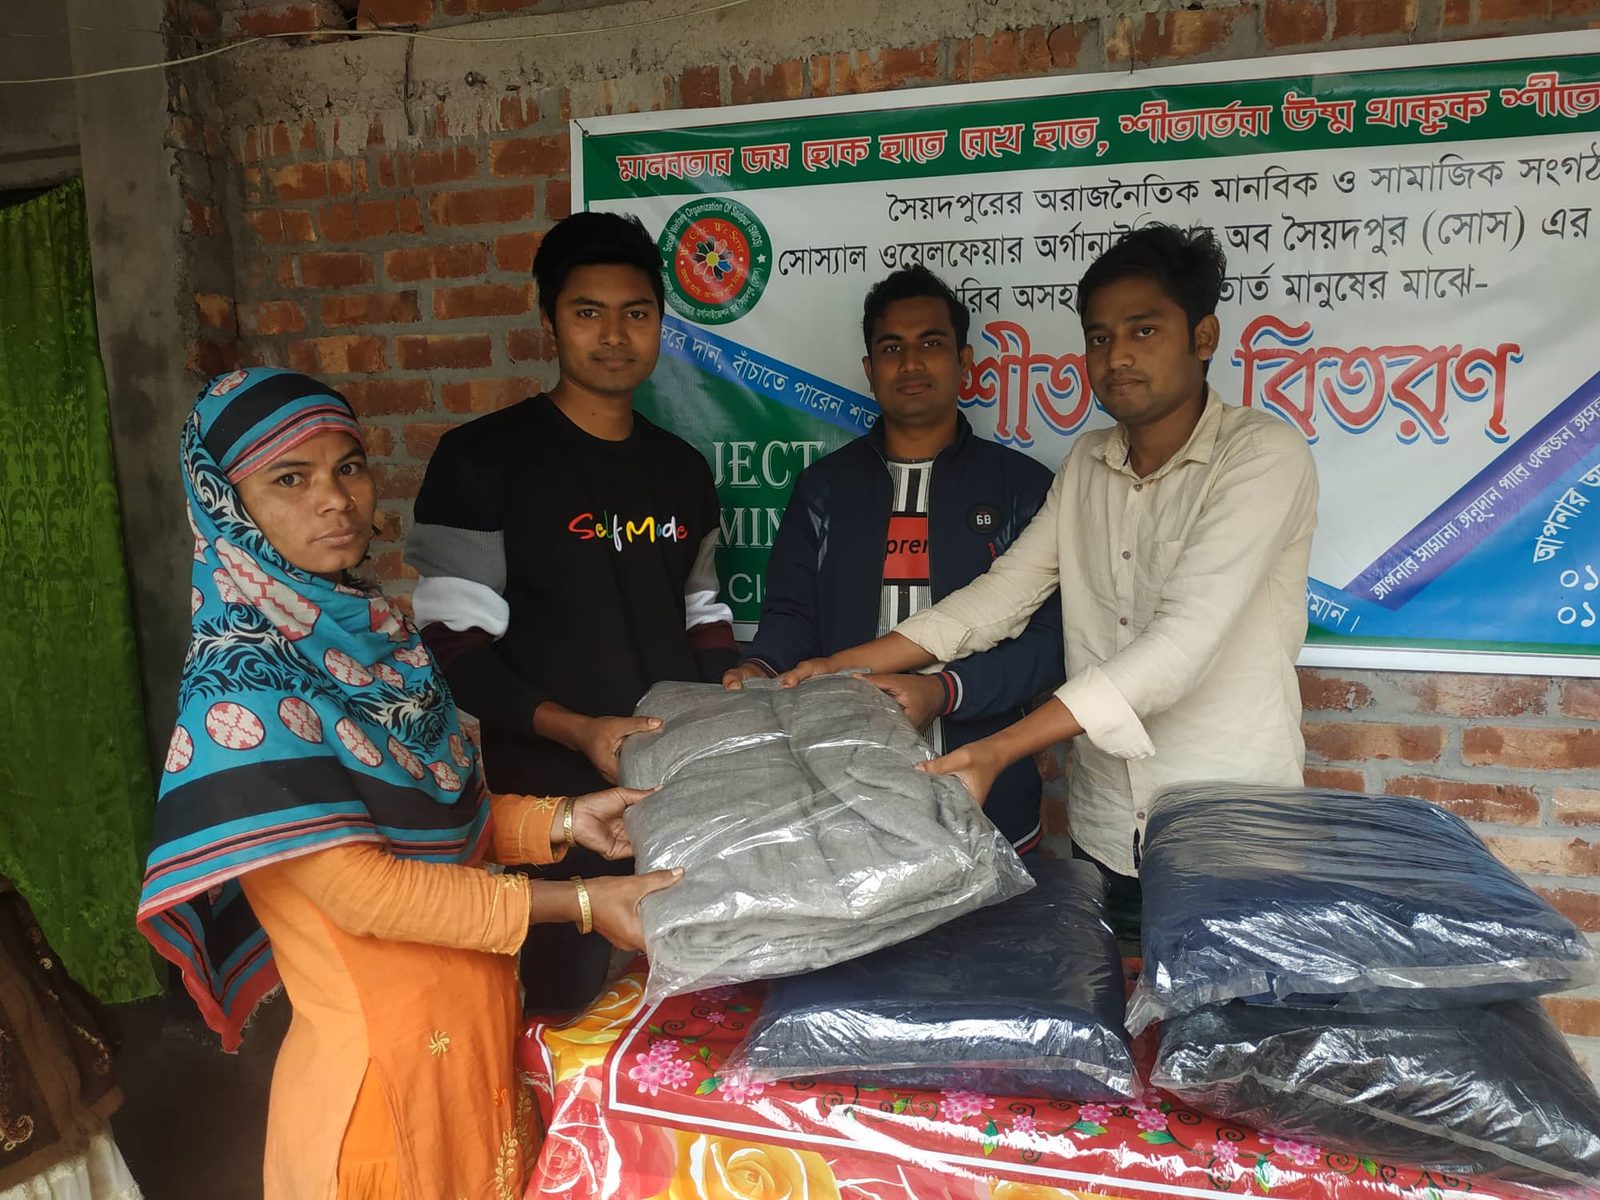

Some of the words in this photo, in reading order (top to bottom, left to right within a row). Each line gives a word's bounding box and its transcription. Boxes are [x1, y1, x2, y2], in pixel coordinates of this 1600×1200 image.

[616, 147, 733, 182] মানবতার
[741, 142, 790, 175] জয়
[802, 136, 870, 171] হোক
[879, 130, 947, 165] হাতে
[959, 123, 1025, 158] রেখে
[1032, 117, 1108, 157] হাত,
[1119, 99, 1272, 143] শীতার্তরা
[1366, 90, 1490, 134] থাকুক
[886, 191, 1024, 224] সৈয়দপুরের
[1033, 173, 1200, 213] অরাজনৈতিক
[1211, 165, 1319, 203] মানবিক
[1333, 170, 1357, 194] ও
[1369, 153, 1505, 193] সামাজিক
[663, 235, 676, 252] Social
[685, 202, 723, 217] Organization
[724, 203, 732, 213] Of
[778, 243, 868, 276] সোস্যাল
[879, 233, 1024, 269] ওয়েলফেয়ার
[1225, 223, 1272, 254] অব
[1281, 213, 1408, 257] সৈয়দপুর
[1422, 205, 1525, 255] (সোস)
[1541, 207, 1592, 239] এর
[1011, 283, 1079, 314] অসহ
[1218, 262, 1275, 305] তার্ত
[1281, 270, 1388, 310] মানুষের
[692, 336, 722, 373] দান,
[732, 350, 789, 391] বাঁচাতে
[794, 382, 844, 417] পারেন
[957, 320, 1092, 448] শীত
[1231, 314, 1523, 446] বিতরণ
[713, 440, 824, 489] JECT
[1455, 486, 1503, 529] অনুদান
[1498, 463, 1531, 491] পারে
[1528, 424, 1576, 469] একজন
[568, 510, 623, 552] Self
[714, 507, 786, 549] MIN
[1532, 487, 1590, 563] আপনার
[728, 573, 766, 603] Cl
